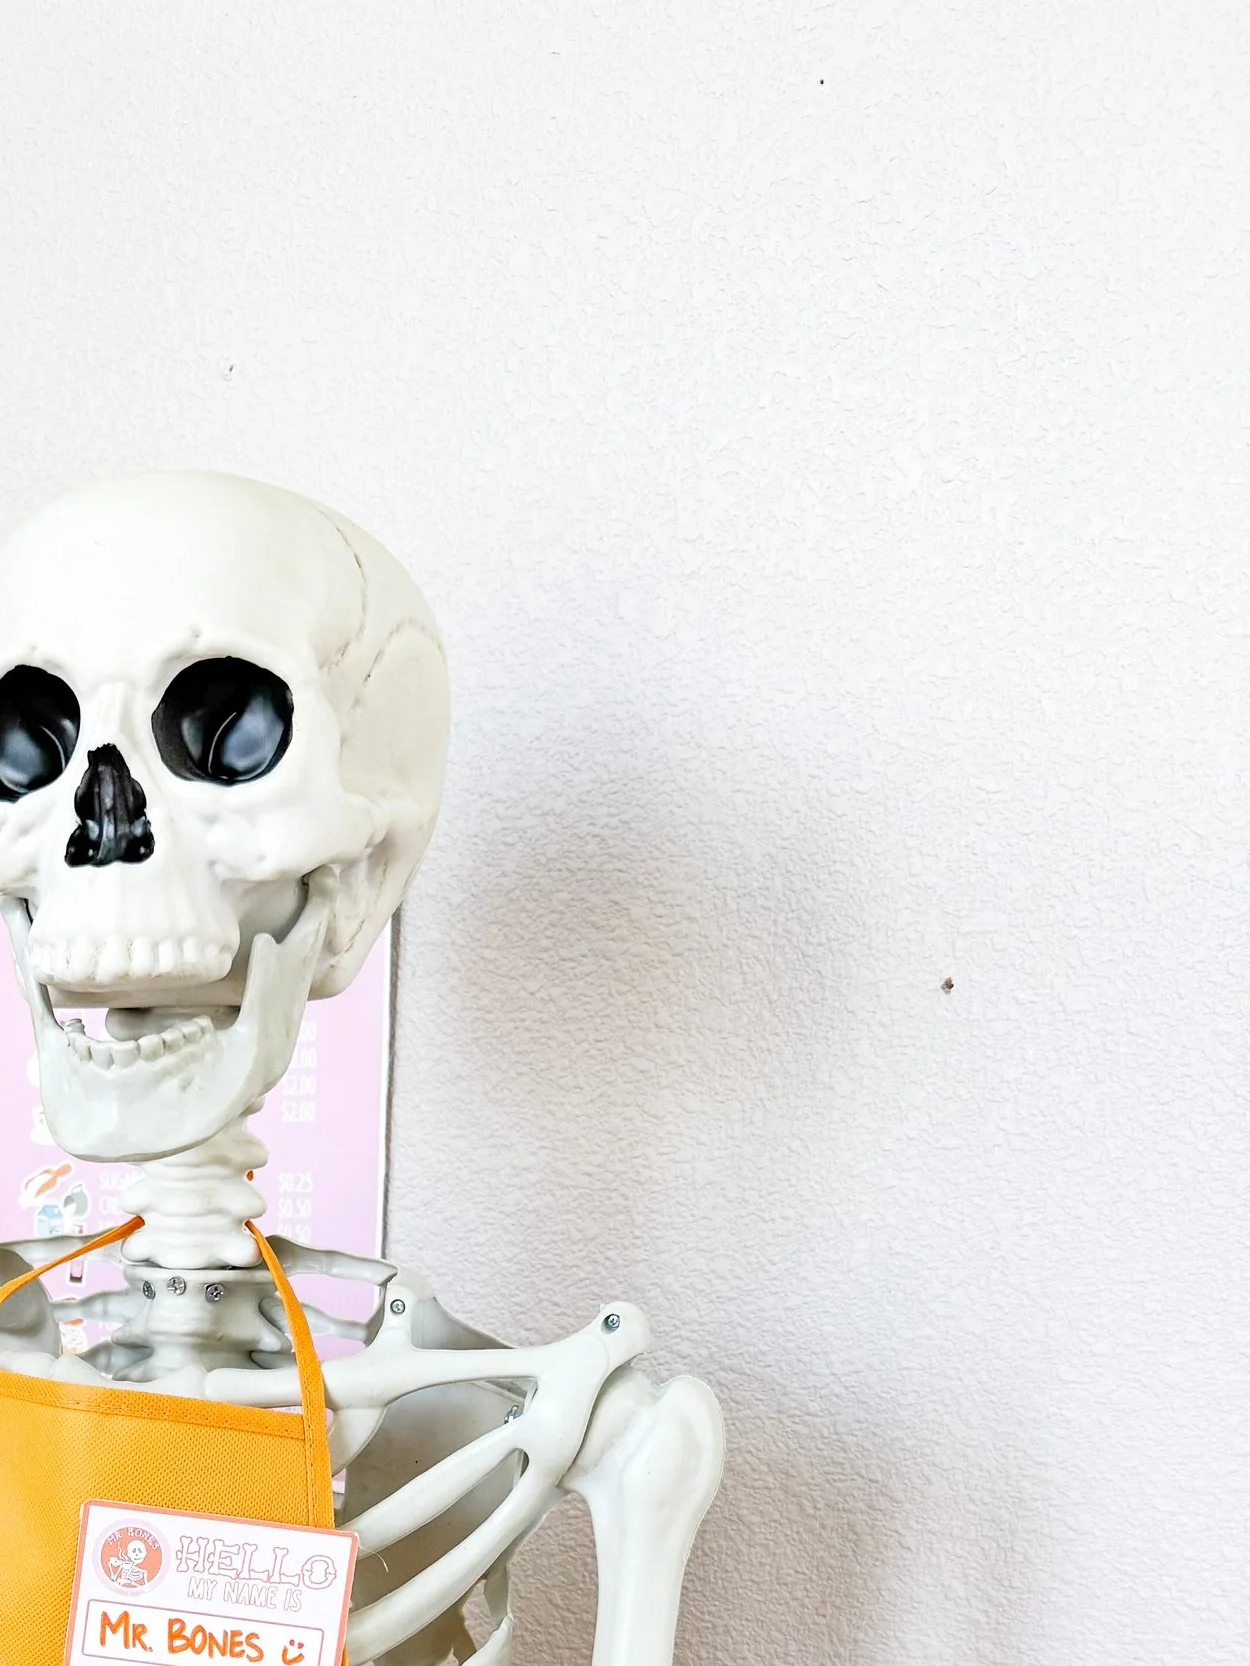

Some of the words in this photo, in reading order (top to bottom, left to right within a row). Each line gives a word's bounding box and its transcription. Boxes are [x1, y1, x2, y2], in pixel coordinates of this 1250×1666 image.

[281, 1102, 316, 1123] $2.00
[278, 1172, 313, 1193] $0.25
[277, 1198, 311, 1219] $0.50
[176, 1535, 337, 1590] HELLO
[188, 1576, 216, 1601] MY
[223, 1581, 277, 1610] NAME
[284, 1588, 302, 1612] IS
[167, 1617, 264, 1663] BONES
